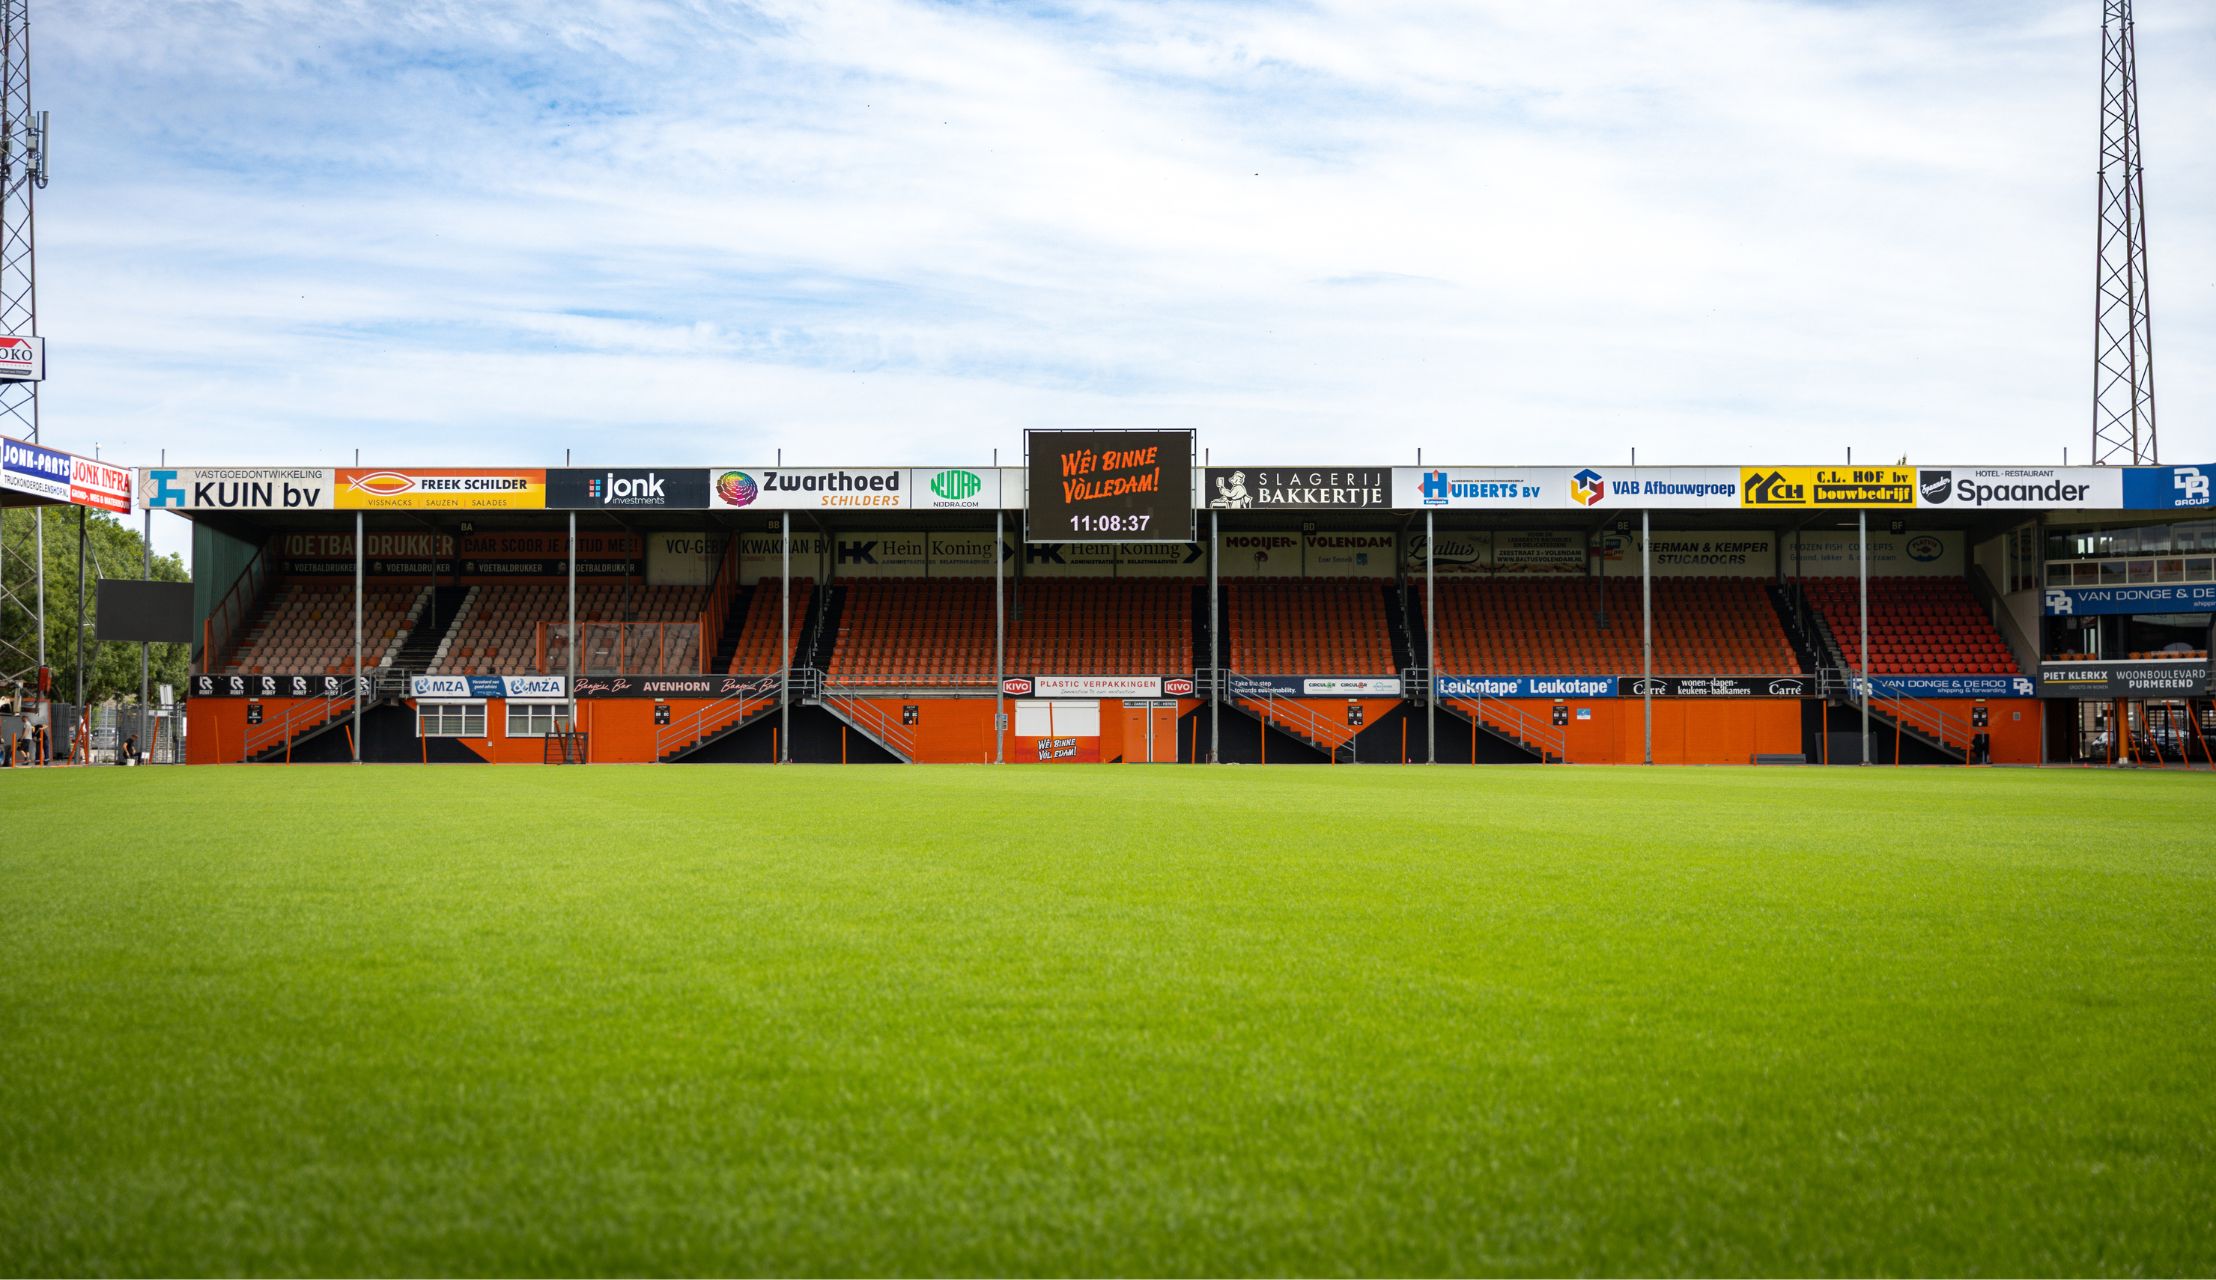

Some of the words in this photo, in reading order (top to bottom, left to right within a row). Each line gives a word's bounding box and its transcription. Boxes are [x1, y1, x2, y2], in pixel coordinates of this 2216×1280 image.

[4, 445, 70, 477] JONK-PARTS
[1060, 449, 1098, 477] WÊI
[1102, 446, 1158, 471] BINNE
[73, 461, 99, 485] JONK
[102, 467, 130, 492] INFRA
[195, 470, 322, 479] VASTGOEDONTWIKKELING
[1259, 472, 1381, 486] SLAGERIJ
[1817, 471, 1846, 483] C.L.
[1853, 471, 1885, 483] HOF
[1892, 472, 1909, 483] bv
[421, 479, 462, 490] FREEK
[464, 479, 528, 490] SCHILDER
[604, 472, 665, 503] jonk
[764, 471, 899, 492] Zwarthoed
[1062, 467, 1160, 504] VÒLLEDAM!
[194, 482, 271, 507] KUIN
[283, 481, 320, 507] bv
[1522, 486, 1541, 498] BV
[1612, 481, 1640, 495] VAB
[1644, 480, 1736, 498] Afbouwgroep
[1817, 486, 1911, 502] bouwbedrijf
[1957, 479, 2090, 506] Spaander
[368, 499, 412, 507] VISSNACKS
[426, 499, 458, 507] SAUZEN
[472, 499, 507, 507] SALADES
[612, 495, 665, 504] investments
[821, 495, 899, 506] SCHILDERS
[1259, 488, 1383, 508] BAKKERTJE
[2174, 498, 2210, 507] GROUP
[1070, 515, 1150, 531] 11:08:37
[501, 539, 544, 553] SCOOR
[882, 541, 922, 555] Hein
[932, 540, 992, 559] Koning
[1226, 537, 1298, 550] MOOIJER-
[1306, 537, 1393, 548] VOLENDAM
[1705, 543, 1712, 552] &
[1715, 543, 1768, 552] KEMPER
[1071, 543, 1111, 555] Hein
[1120, 543, 1181, 559] Koning
[386, 563, 451, 572] VOETBALDRUKER
[479, 563, 543, 572] VOETBALDRUKKER
[574, 563, 635, 572] OETBALDRUKKR
[2078, 591, 2110, 601] VAN
[2116, 589, 2172, 600] DONGE
[2176, 588, 2188, 598] &
[2193, 588, 2215, 598] DE
[2043, 672, 2065, 680] PIET
[2068, 671, 2108, 680] KLERKX
[2116, 669, 2206, 681] WOONBOULEVARD
[432, 681, 464, 692] MZA
[529, 681, 560, 692] MZA
[643, 681, 710, 692] AVENHORN
[1005, 683, 1028, 691] KIVO
[1167, 683, 1190, 691] KIVO
[1633, 683, 1666, 695] Crré
[1678, 685, 1751, 695] keukens-badkamers
[1768, 683, 1802, 695] Carré
[1881, 680, 1905, 688] VAN
[1908, 680, 1949, 688] DONGE
[1952, 680, 1961, 688] &
[2129, 679, 2194, 689] PURMEREND
[1054, 738, 1076, 748] BINNE
[1038, 746, 1077, 761] VÒLEDAM!
